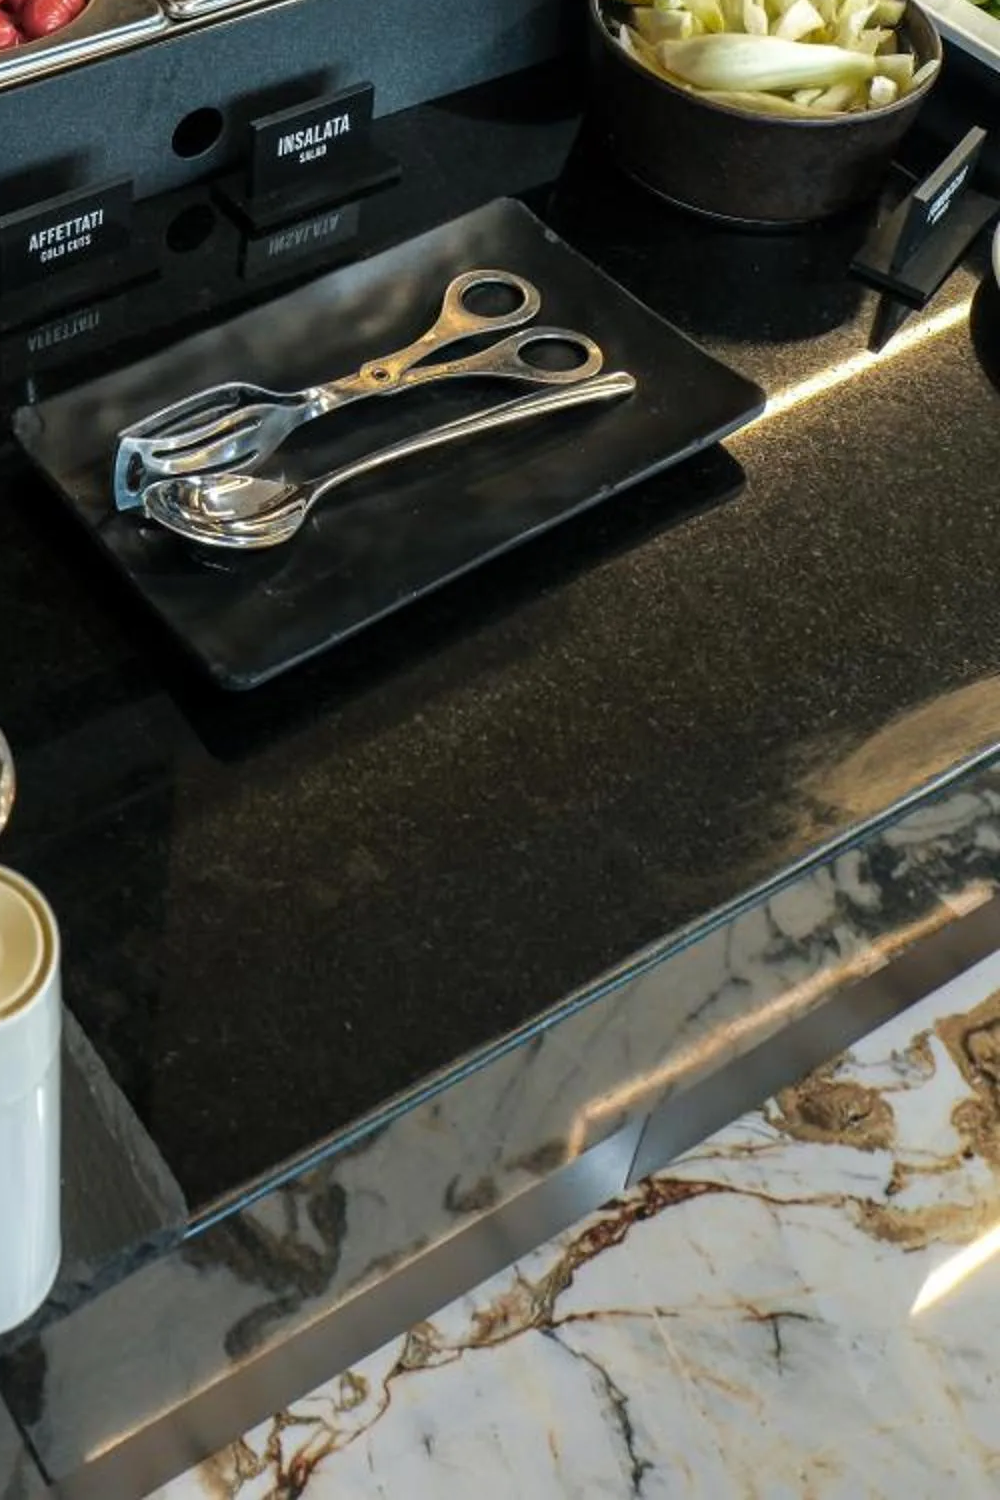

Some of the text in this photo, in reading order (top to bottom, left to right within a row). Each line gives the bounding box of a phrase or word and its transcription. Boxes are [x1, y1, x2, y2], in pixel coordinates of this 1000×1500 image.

[277, 113, 350, 157] INSALATA
[29, 209, 104, 253] AFFETTATI
[40, 243, 65, 263] COLD
